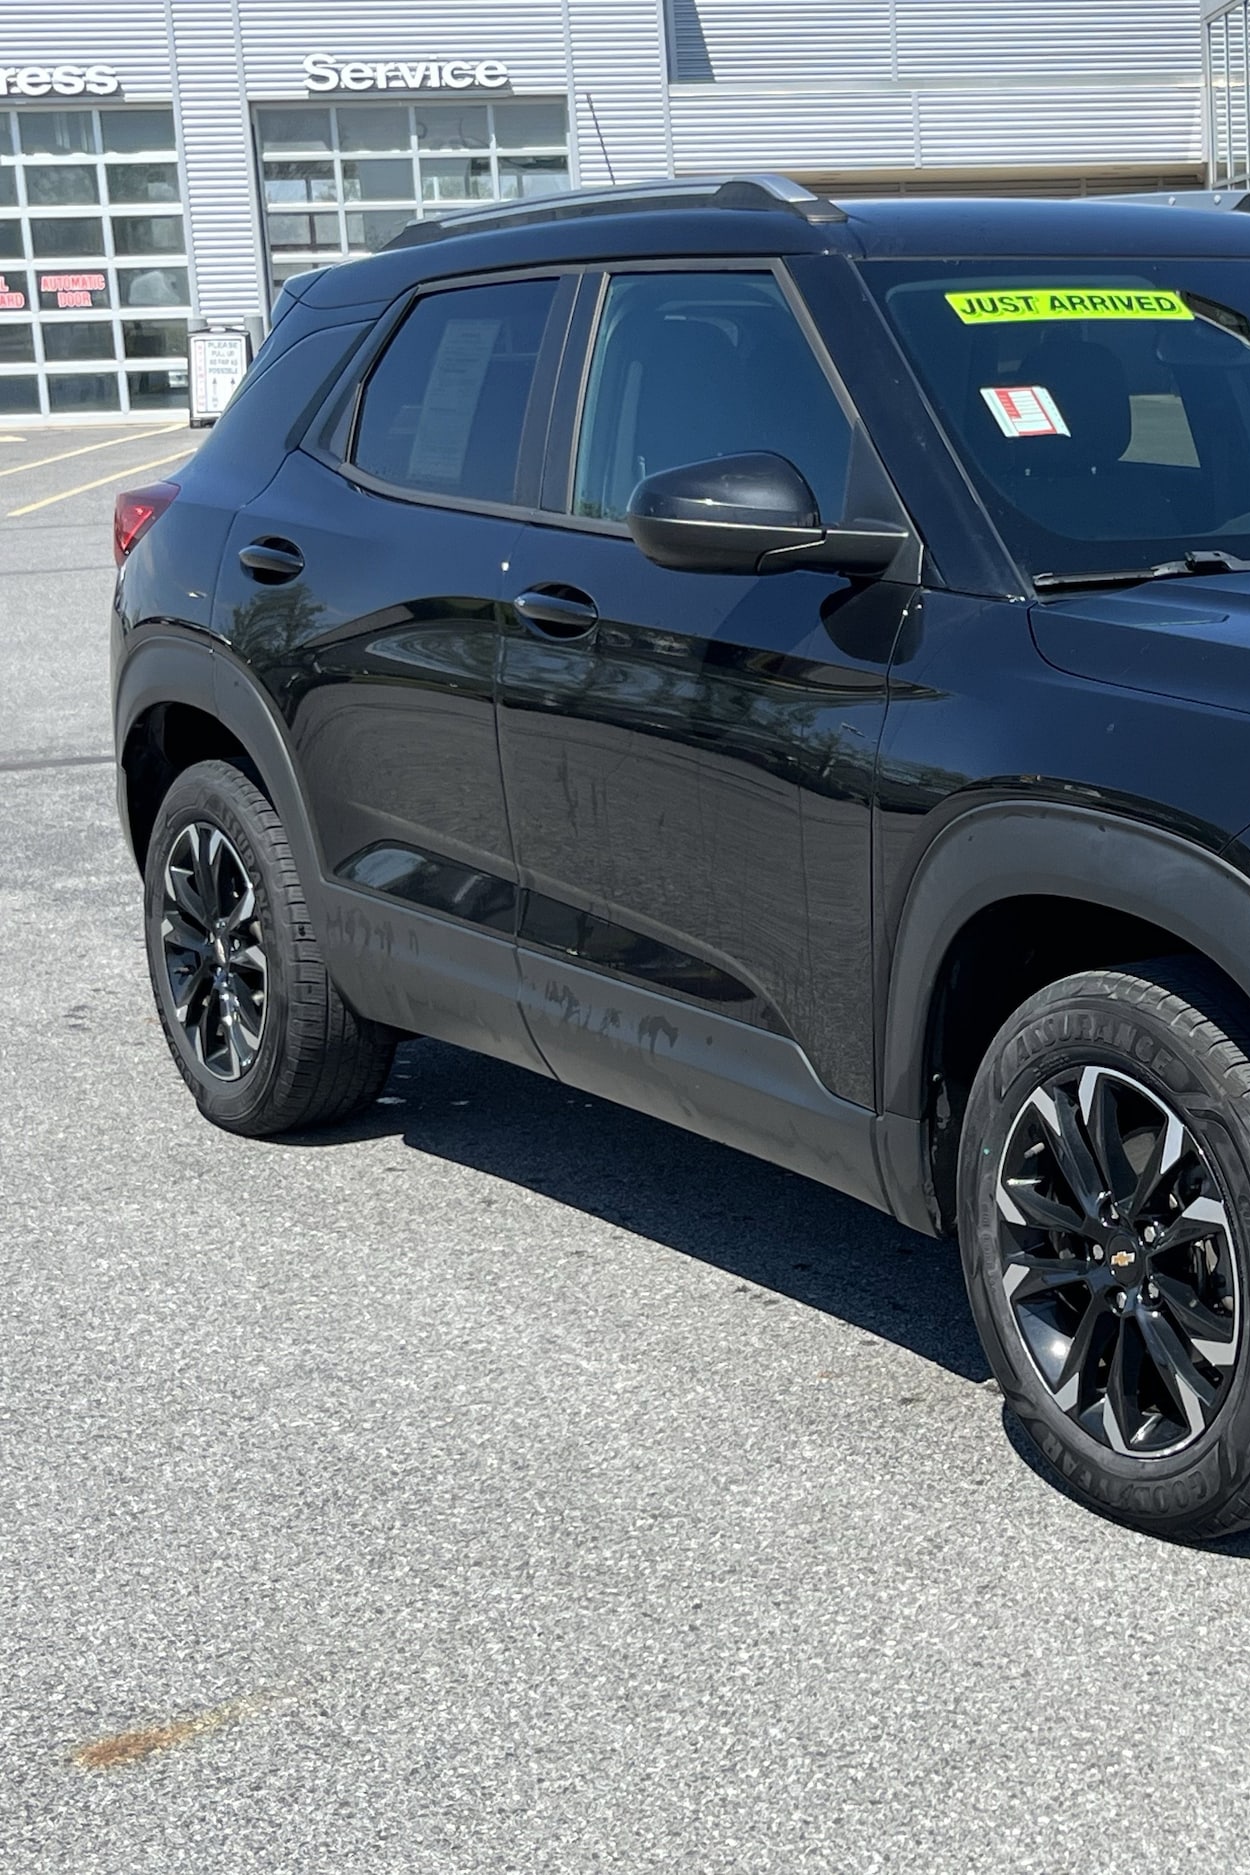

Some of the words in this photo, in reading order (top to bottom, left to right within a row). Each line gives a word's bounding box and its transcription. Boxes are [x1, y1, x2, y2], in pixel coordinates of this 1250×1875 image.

[302, 53, 508, 92] Service
[42, 275, 105, 292] AUTOMATIC
[58, 292, 92, 307] DOOR
[961, 295, 1036, 316] JUST
[1050, 294, 1180, 313] ARRIVED
[1016, 1013, 1174, 1079] ASSURANCE
[1041, 1432, 1208, 1514] GOODYEAR
